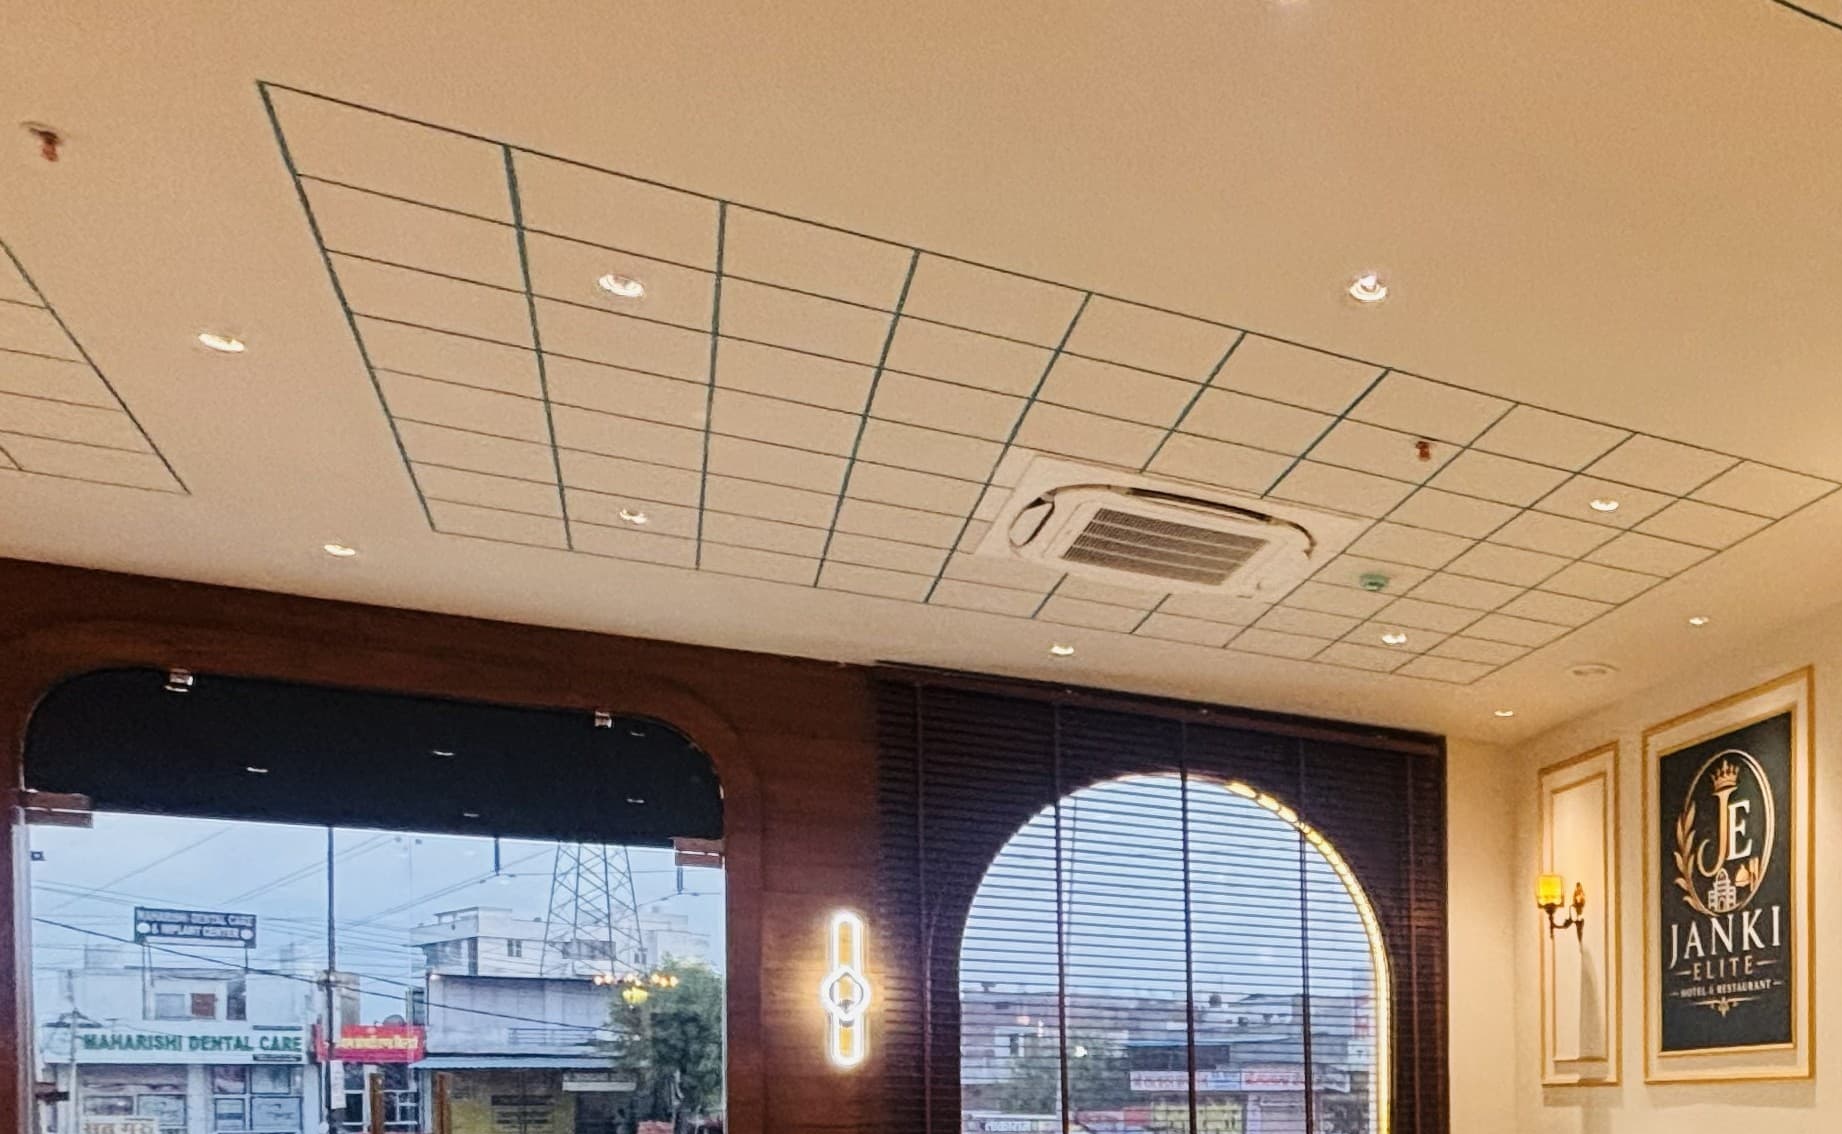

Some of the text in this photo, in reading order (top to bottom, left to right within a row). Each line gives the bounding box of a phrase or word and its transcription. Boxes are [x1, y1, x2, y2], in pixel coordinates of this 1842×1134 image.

[1669, 905, 1781, 970] JANKI
[1692, 955, 1754, 981] ELITE
[1680, 986, 1706, 998] HOTEL
[1716, 979, 1772, 995] RESTAURANT
[83, 1033, 183, 1051] MAHARISHI
[188, 1034, 254, 1051] DENTAL
[259, 1035, 303, 1051] CARE
